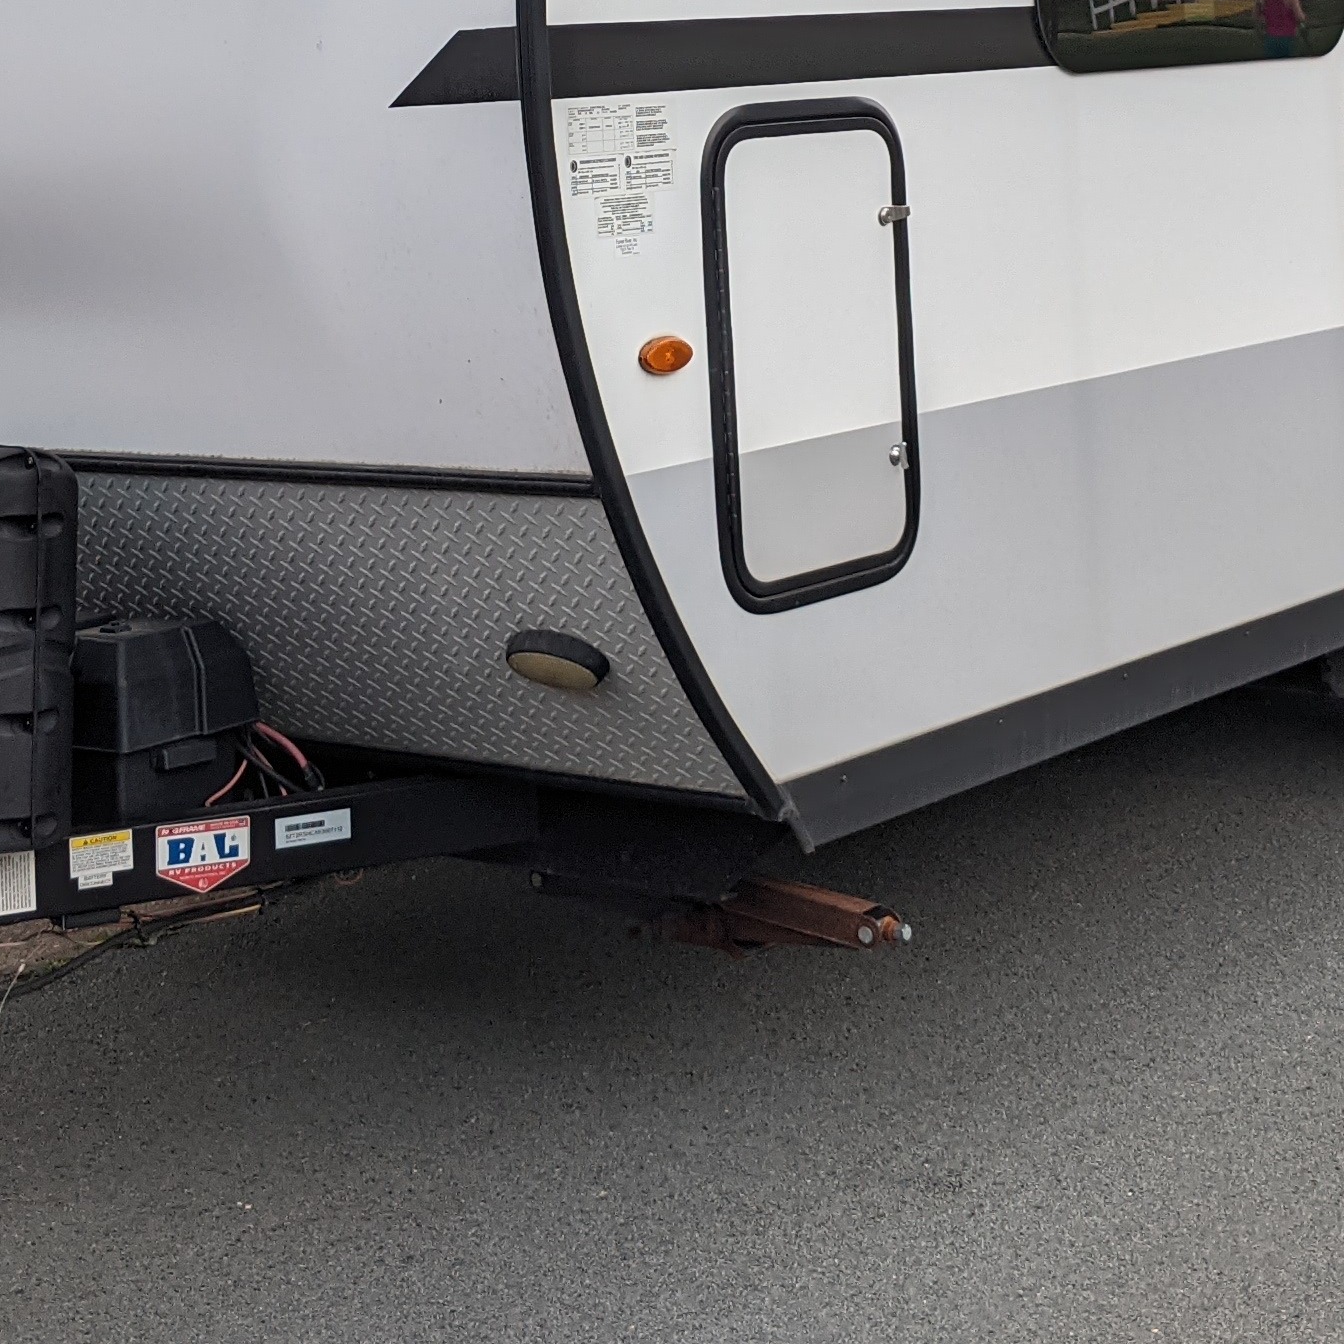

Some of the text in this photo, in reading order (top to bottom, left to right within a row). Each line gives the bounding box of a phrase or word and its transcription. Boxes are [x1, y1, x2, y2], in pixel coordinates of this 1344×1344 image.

[89, 835, 118, 844] CAUTION
[167, 832, 240, 866] BAL
[184, 862, 237, 874] PRODUCTS
